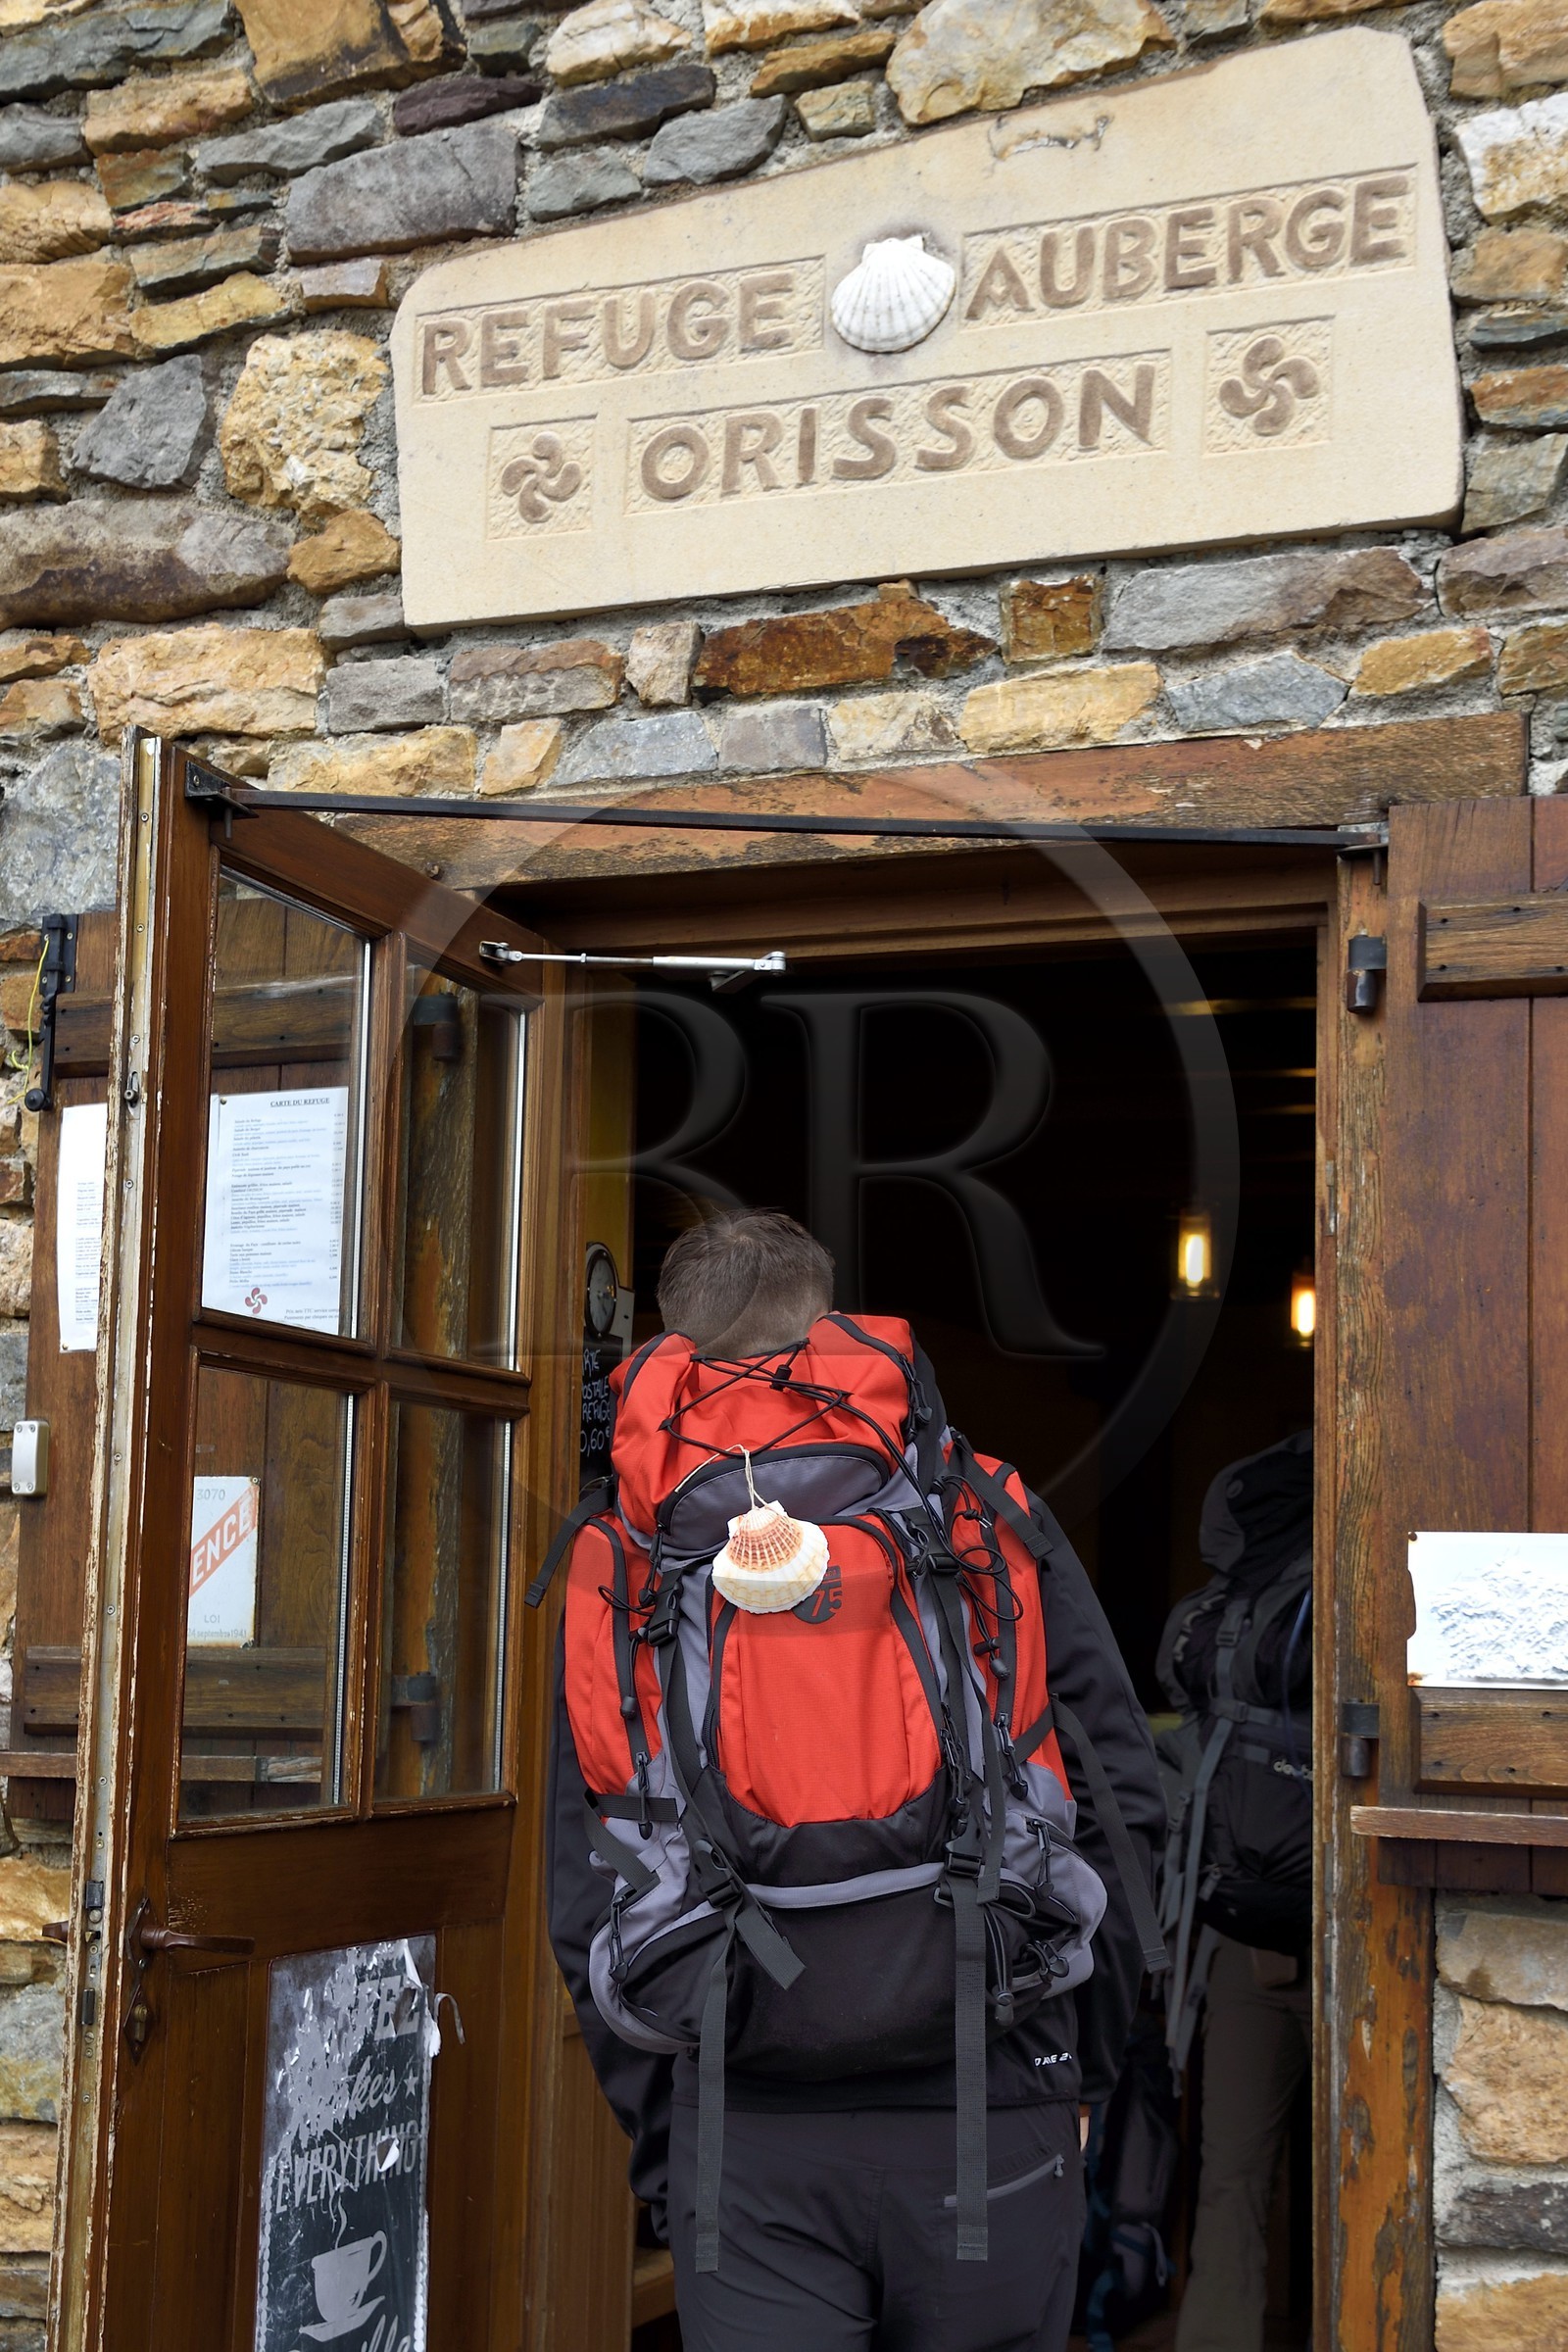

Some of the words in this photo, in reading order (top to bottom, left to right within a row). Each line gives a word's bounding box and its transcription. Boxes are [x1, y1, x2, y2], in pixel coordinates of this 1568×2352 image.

[963, 174, 1412, 321] AUBERGE
[421, 271, 796, 396] REFUGE
[640, 364, 1156, 503] ORISSON
[270, 1100, 292, 1108] CARTE
[204, 1614, 220, 1624] LOI
[275, 2119, 420, 2214] EVERYTHNG
